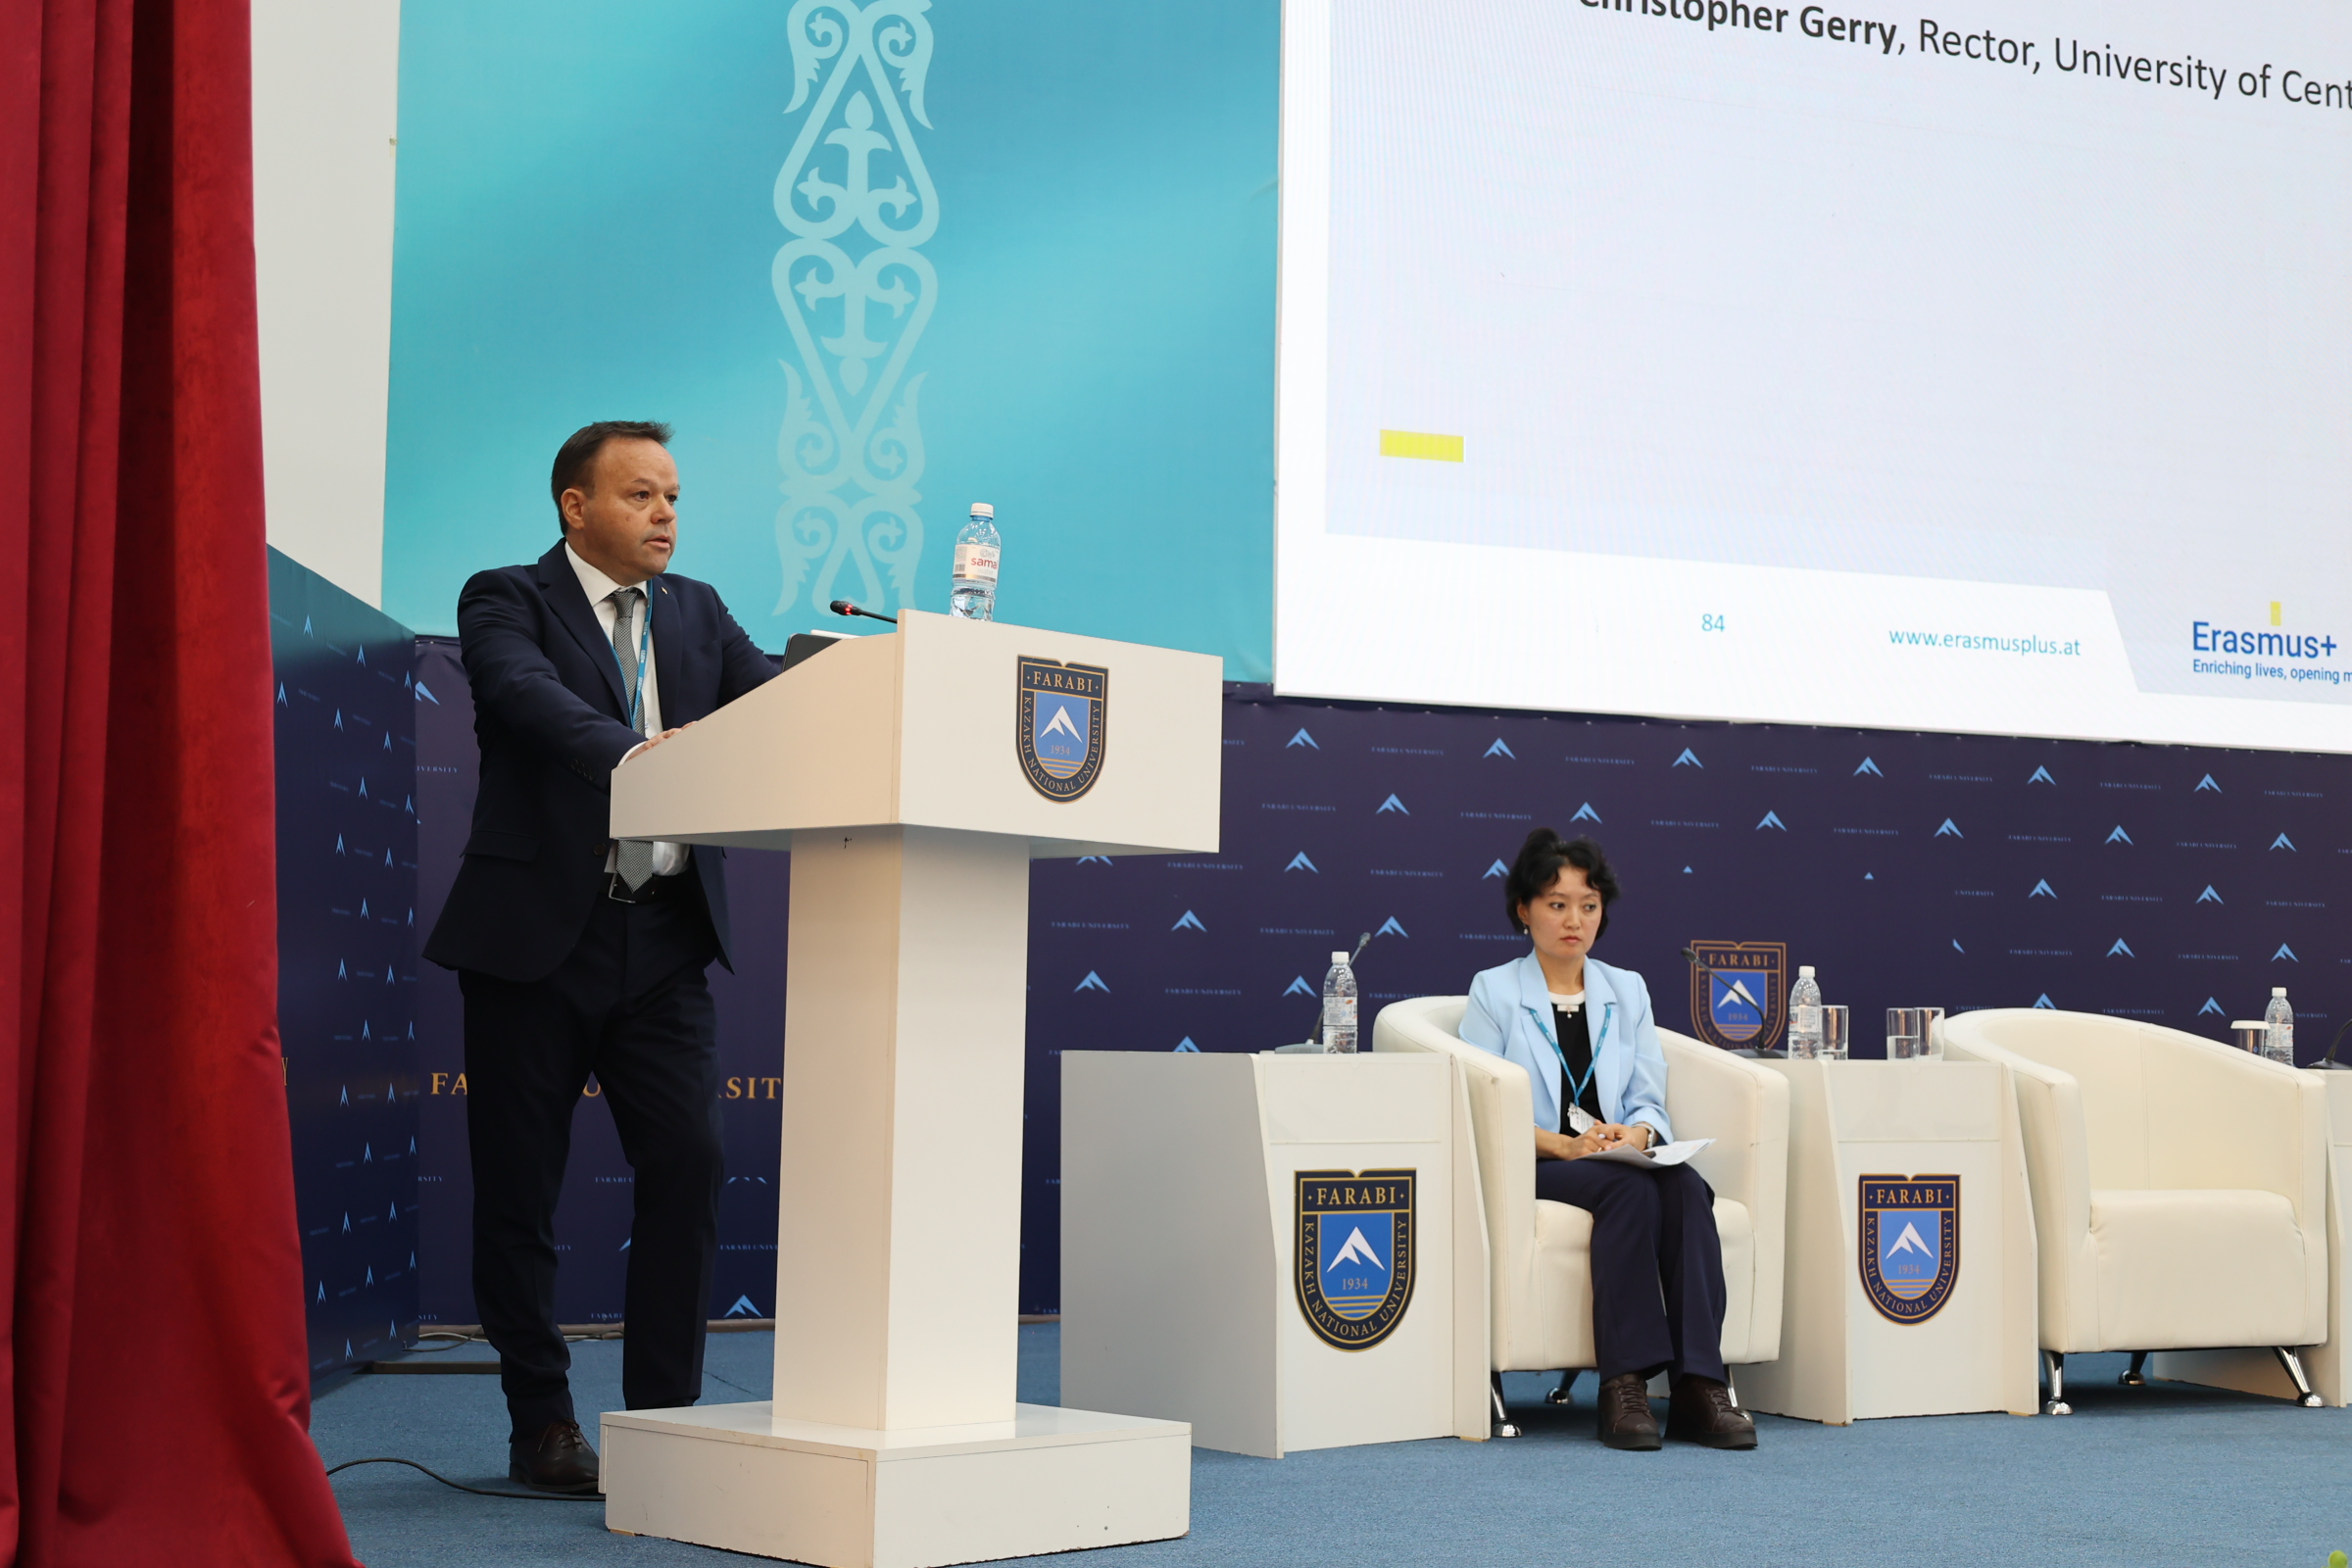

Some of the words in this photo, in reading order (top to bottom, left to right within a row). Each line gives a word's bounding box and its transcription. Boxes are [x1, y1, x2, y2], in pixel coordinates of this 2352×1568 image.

[1799, 6, 1906, 55] Gerry,
[1920, 19, 2041, 75] Rector,
[2055, 37, 2228, 100] University
[2237, 64, 2273, 99] of
[1701, 613, 1726, 633] 84
[1888, 627, 2082, 657] www.erasmusplus.at
[2193, 620, 2337, 659] Erasmus+
[1033, 670, 1093, 693] FARABI
[2193, 659, 2252, 679] Enriching
[2255, 662, 2287, 680] lives,
[2290, 667, 2340, 685] opening
[1023, 697, 1032, 753] KAZAKH
[1028, 758, 1077, 792] NATIONAL
[1077, 706, 1101, 784] UNIVERSITY
[1051, 745, 1071, 756] 1934
[1709, 953, 1769, 967] FARABI
[1316, 1187, 1396, 1205] FARABI
[1876, 1189, 1943, 1203] FARABI
[1867, 1217, 1877, 1277] KAZAKH
[1873, 1282, 1928, 1313] NATIONAL
[1929, 1216, 1952, 1301] UNIVERSITY
[1898, 1264, 1921, 1274] 1934
[1304, 1221, 1316, 1296] KAZAKH
[1311, 1299, 1378, 1337] NATIONAL
[1379, 1220, 1407, 1322] UNIVERSITY
[1342, 1278, 1369, 1291] 1934
